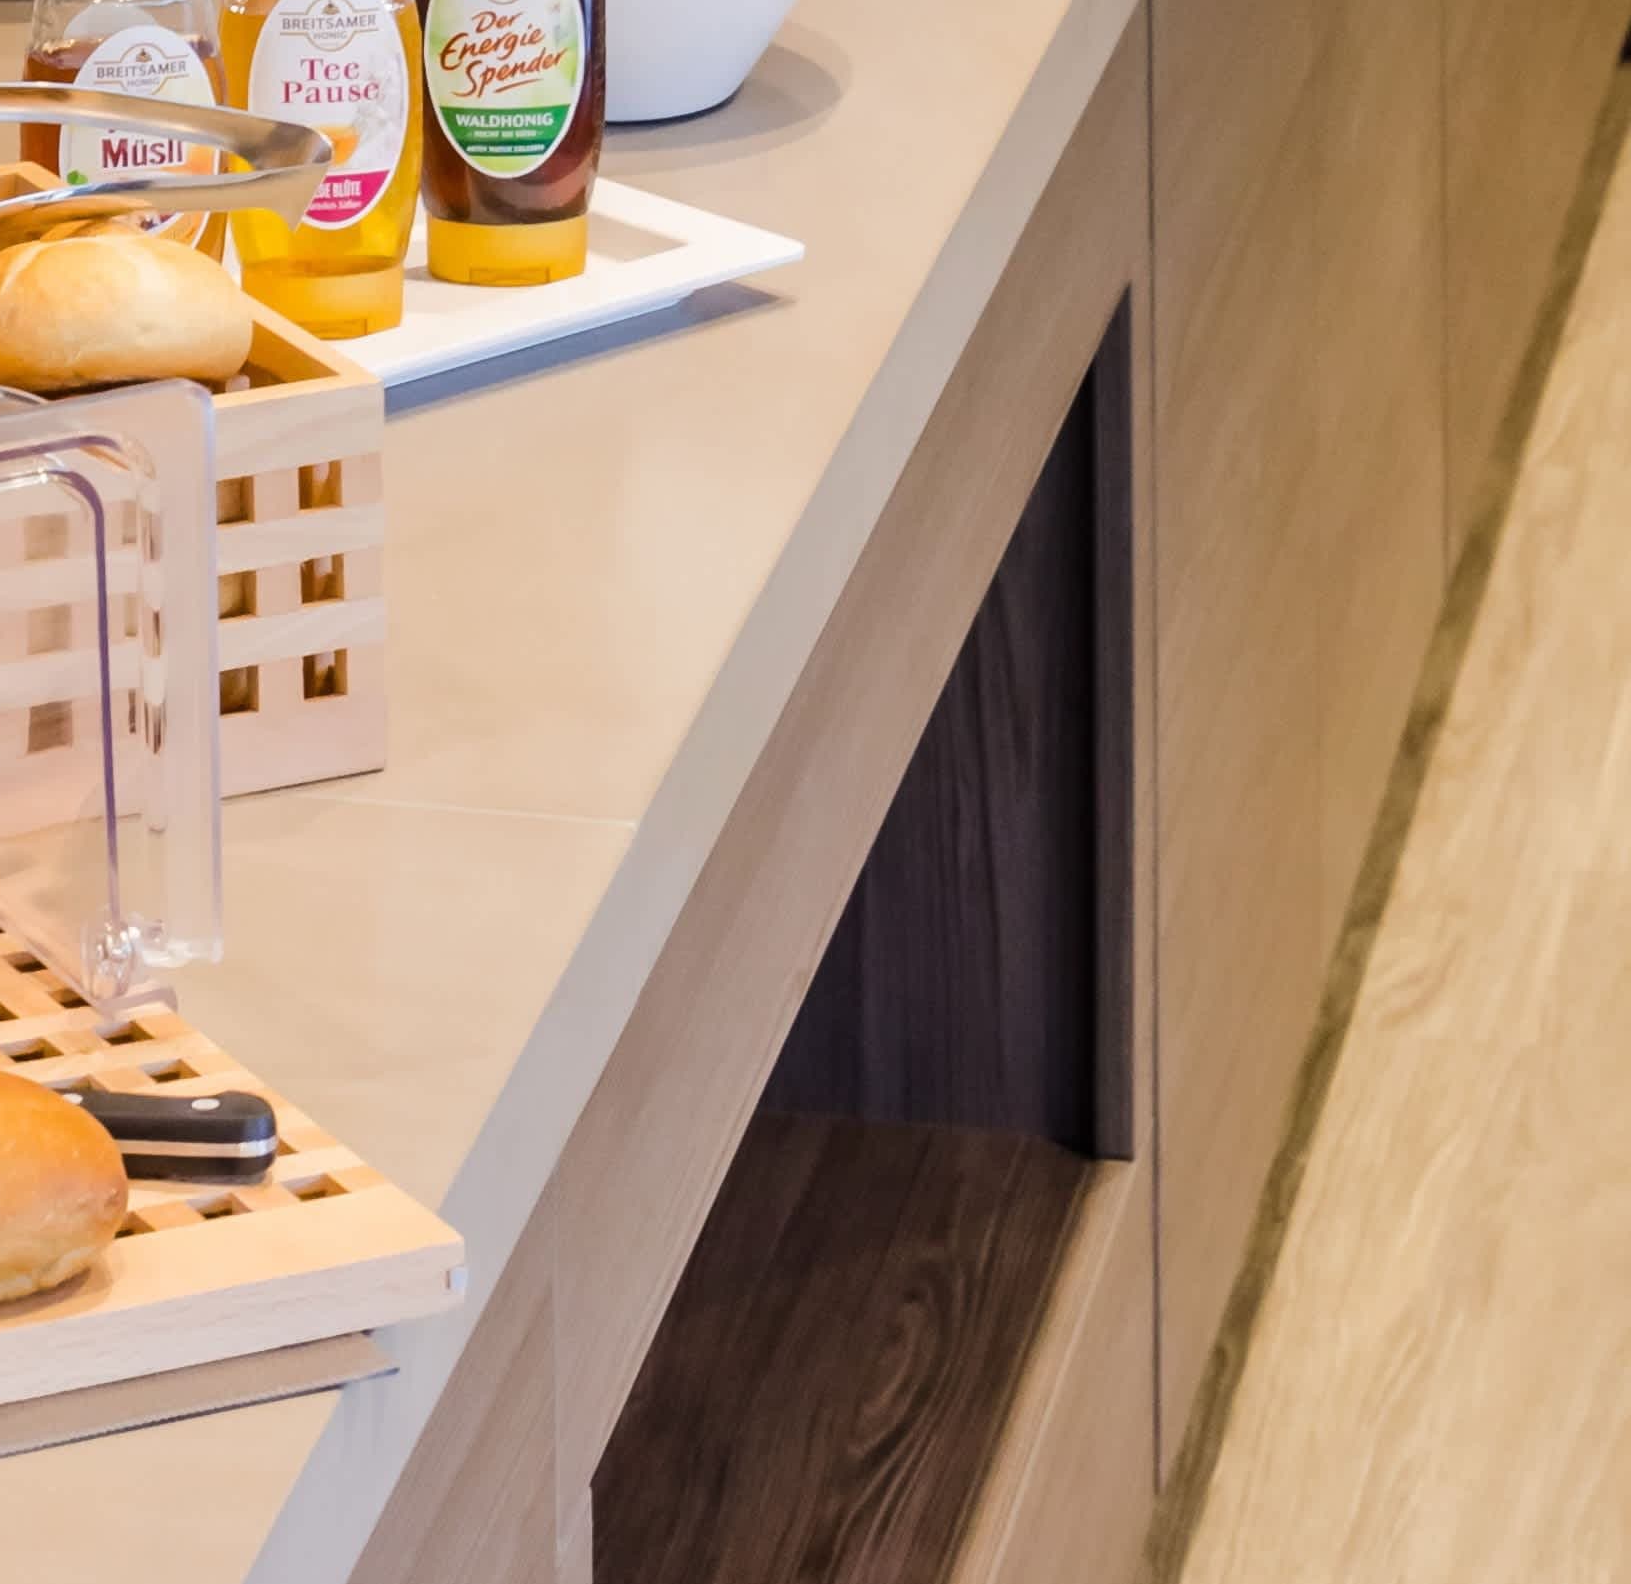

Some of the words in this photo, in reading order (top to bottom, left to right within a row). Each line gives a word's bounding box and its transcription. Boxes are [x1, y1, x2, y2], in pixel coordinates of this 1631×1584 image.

[281, 15, 377, 31] BREITSAMER
[471, 10, 523, 34] Der
[439, 24, 545, 72] Energie
[96, 60, 187, 79] BREITSAMER
[300, 58, 361, 82] Tee
[452, 46, 568, 99] Spender
[281, 81, 381, 104] Pause
[455, 112, 555, 129] WALDHONIG
